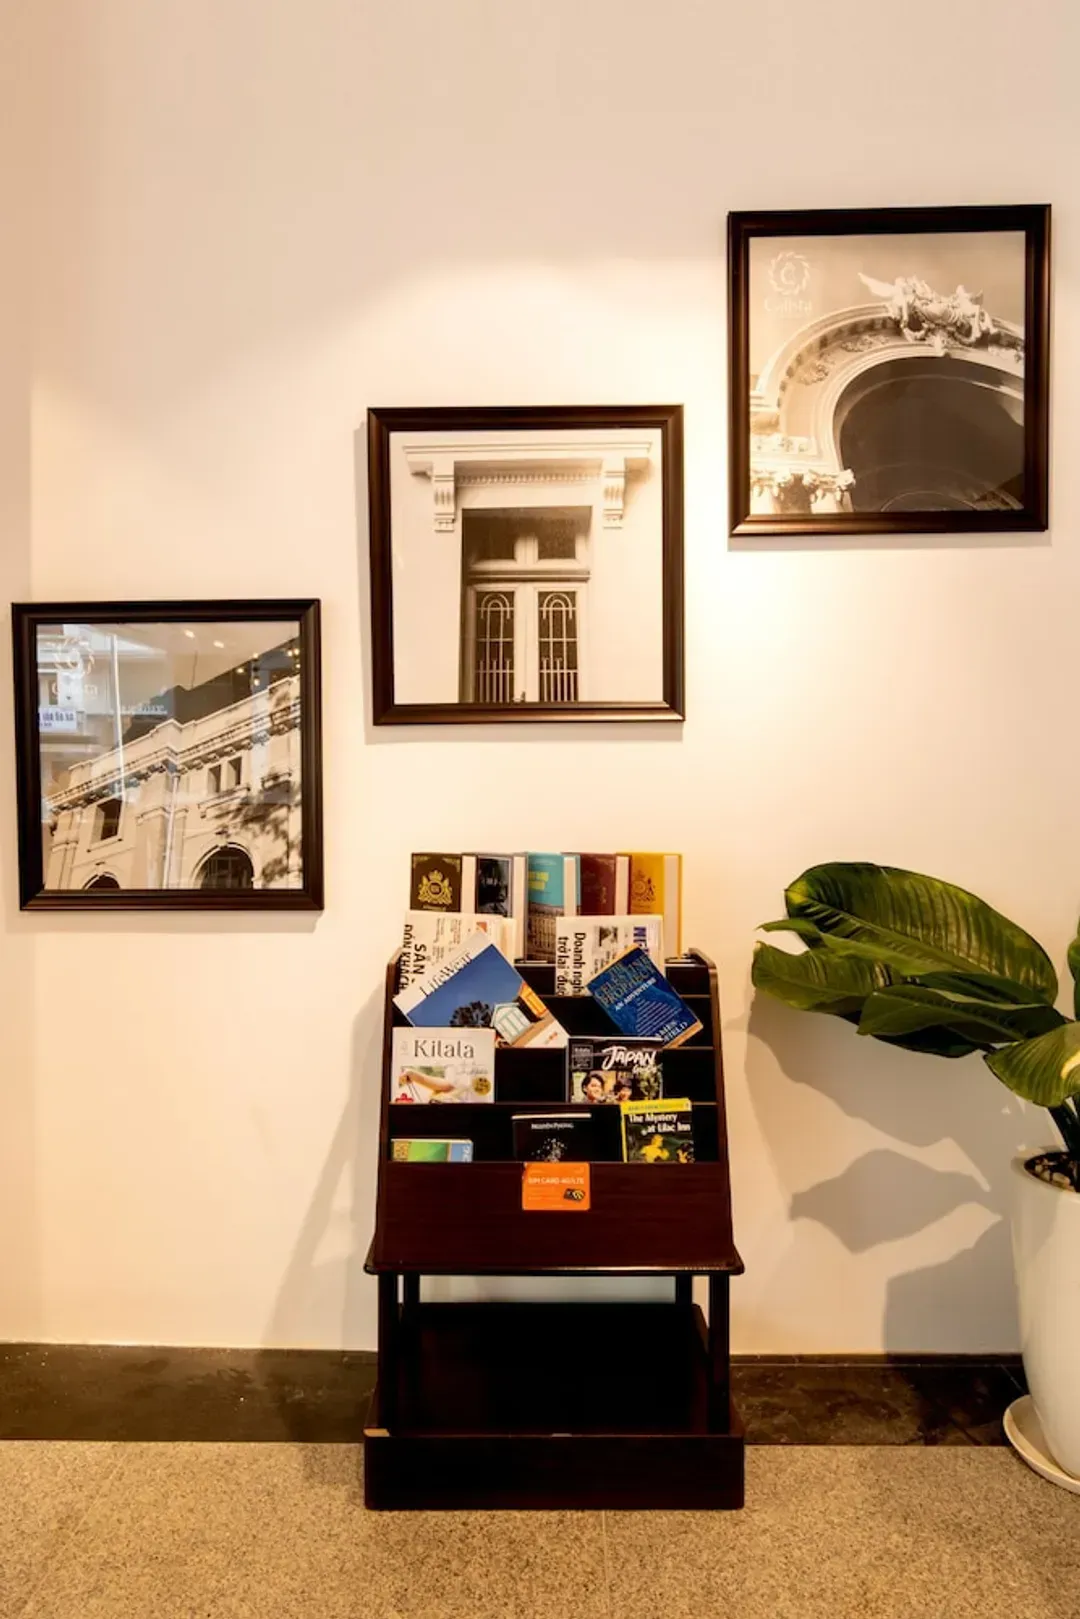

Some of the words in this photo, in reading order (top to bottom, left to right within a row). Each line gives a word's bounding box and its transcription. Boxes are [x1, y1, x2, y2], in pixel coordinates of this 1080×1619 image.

[573, 932, 586, 969] Doanh
[419, 952, 472, 997] LifeWear
[614, 1001, 625, 1012] AN
[625, 976, 656, 1003] ADVENTURE
[601, 1045, 656, 1070] JAPAN
[629, 1113, 644, 1124] The
[645, 1112, 678, 1124] Mystery
[647, 1123, 656, 1133] at
[657, 1122, 675, 1133] Lilac
[677, 1121, 692, 1132] Inn
